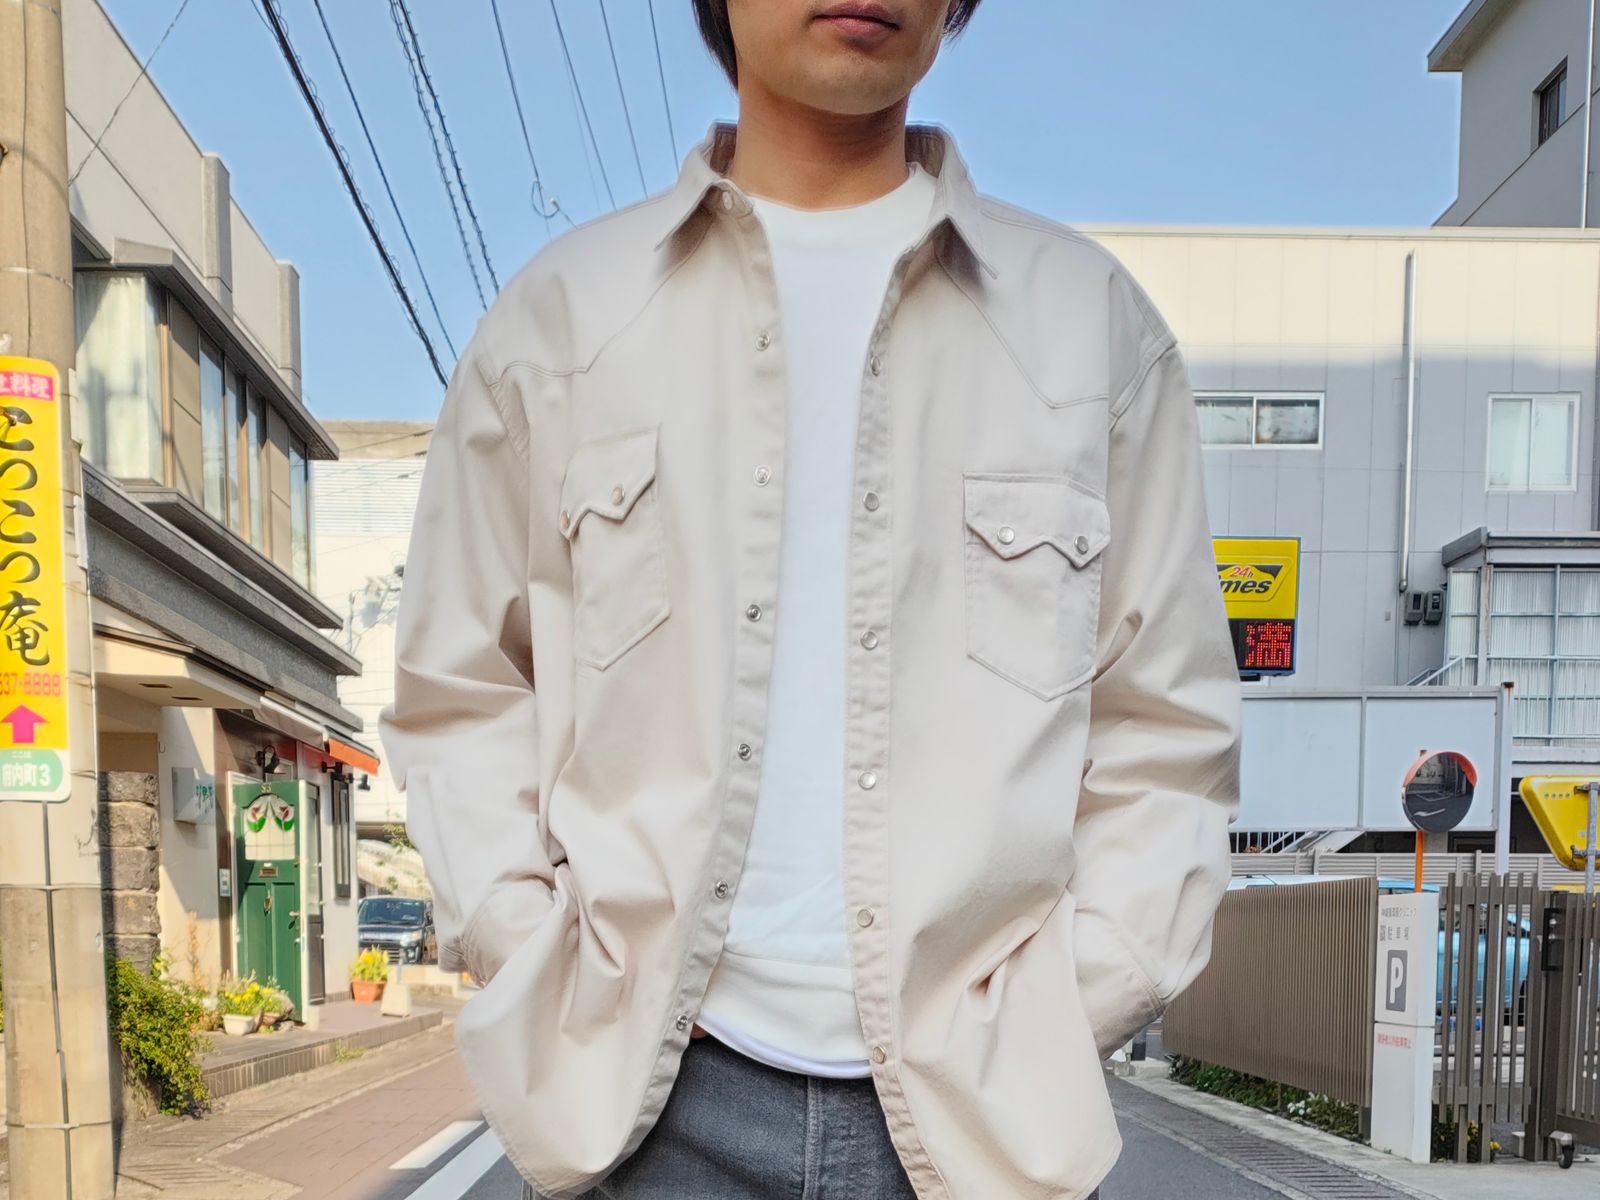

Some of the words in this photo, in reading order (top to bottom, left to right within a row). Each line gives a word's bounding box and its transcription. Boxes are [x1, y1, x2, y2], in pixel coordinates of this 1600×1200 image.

[1218, 575, 1273, 594] mes
[1244, 622, 1292, 667] 満
[1389, 957, 1404, 1004] P
